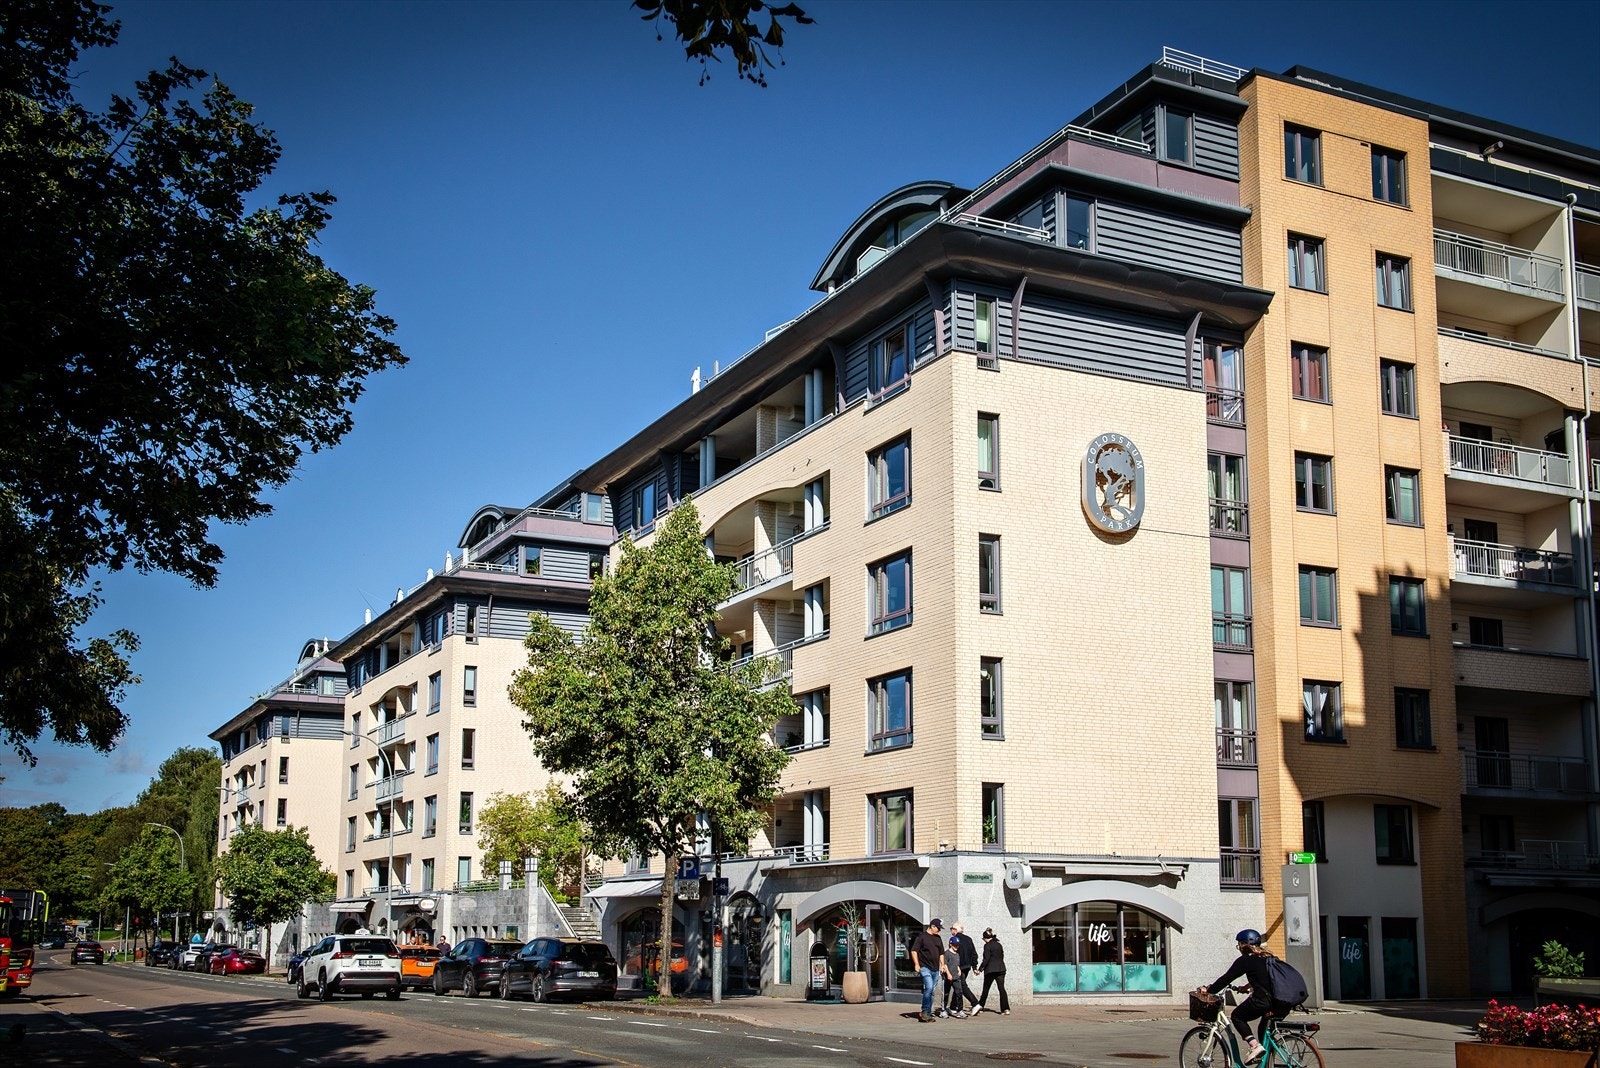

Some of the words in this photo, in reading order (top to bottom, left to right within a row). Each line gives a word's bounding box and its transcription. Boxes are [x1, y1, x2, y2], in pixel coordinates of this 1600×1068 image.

[1088, 435, 1143, 469] COLOSSEUM
[1101, 516, 1132, 530] PARK
[683, 860, 695, 877] P
[1088, 923, 1110, 945] life
[1343, 942, 1361, 963] life
